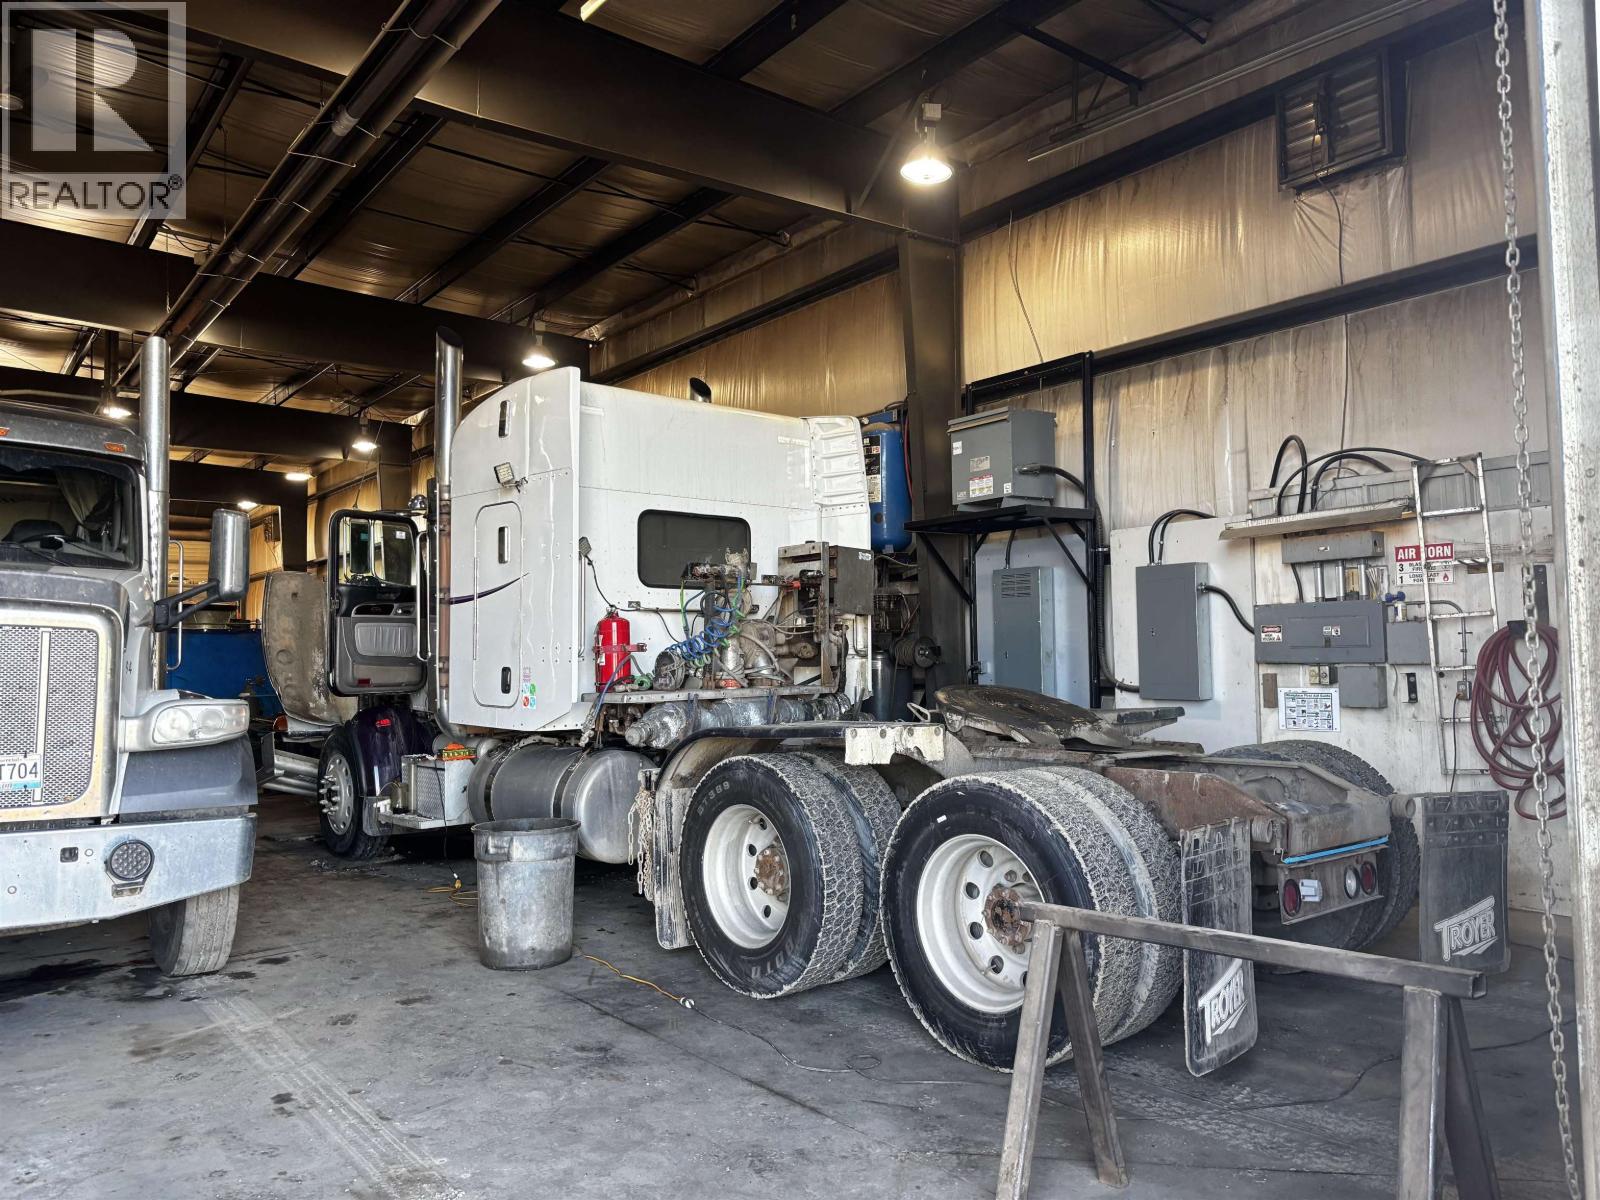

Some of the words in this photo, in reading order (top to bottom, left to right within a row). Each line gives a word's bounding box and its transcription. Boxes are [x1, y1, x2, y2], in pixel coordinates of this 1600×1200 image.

[1398, 548, 1417, 560] AIR
[1425, 545, 1451, 558] ORN
[1398, 563, 1404, 572] 3
[1399, 575, 1404, 584] 1
[1433, 895, 1496, 961] TROYER
[1198, 958, 1245, 1045] TROYER
